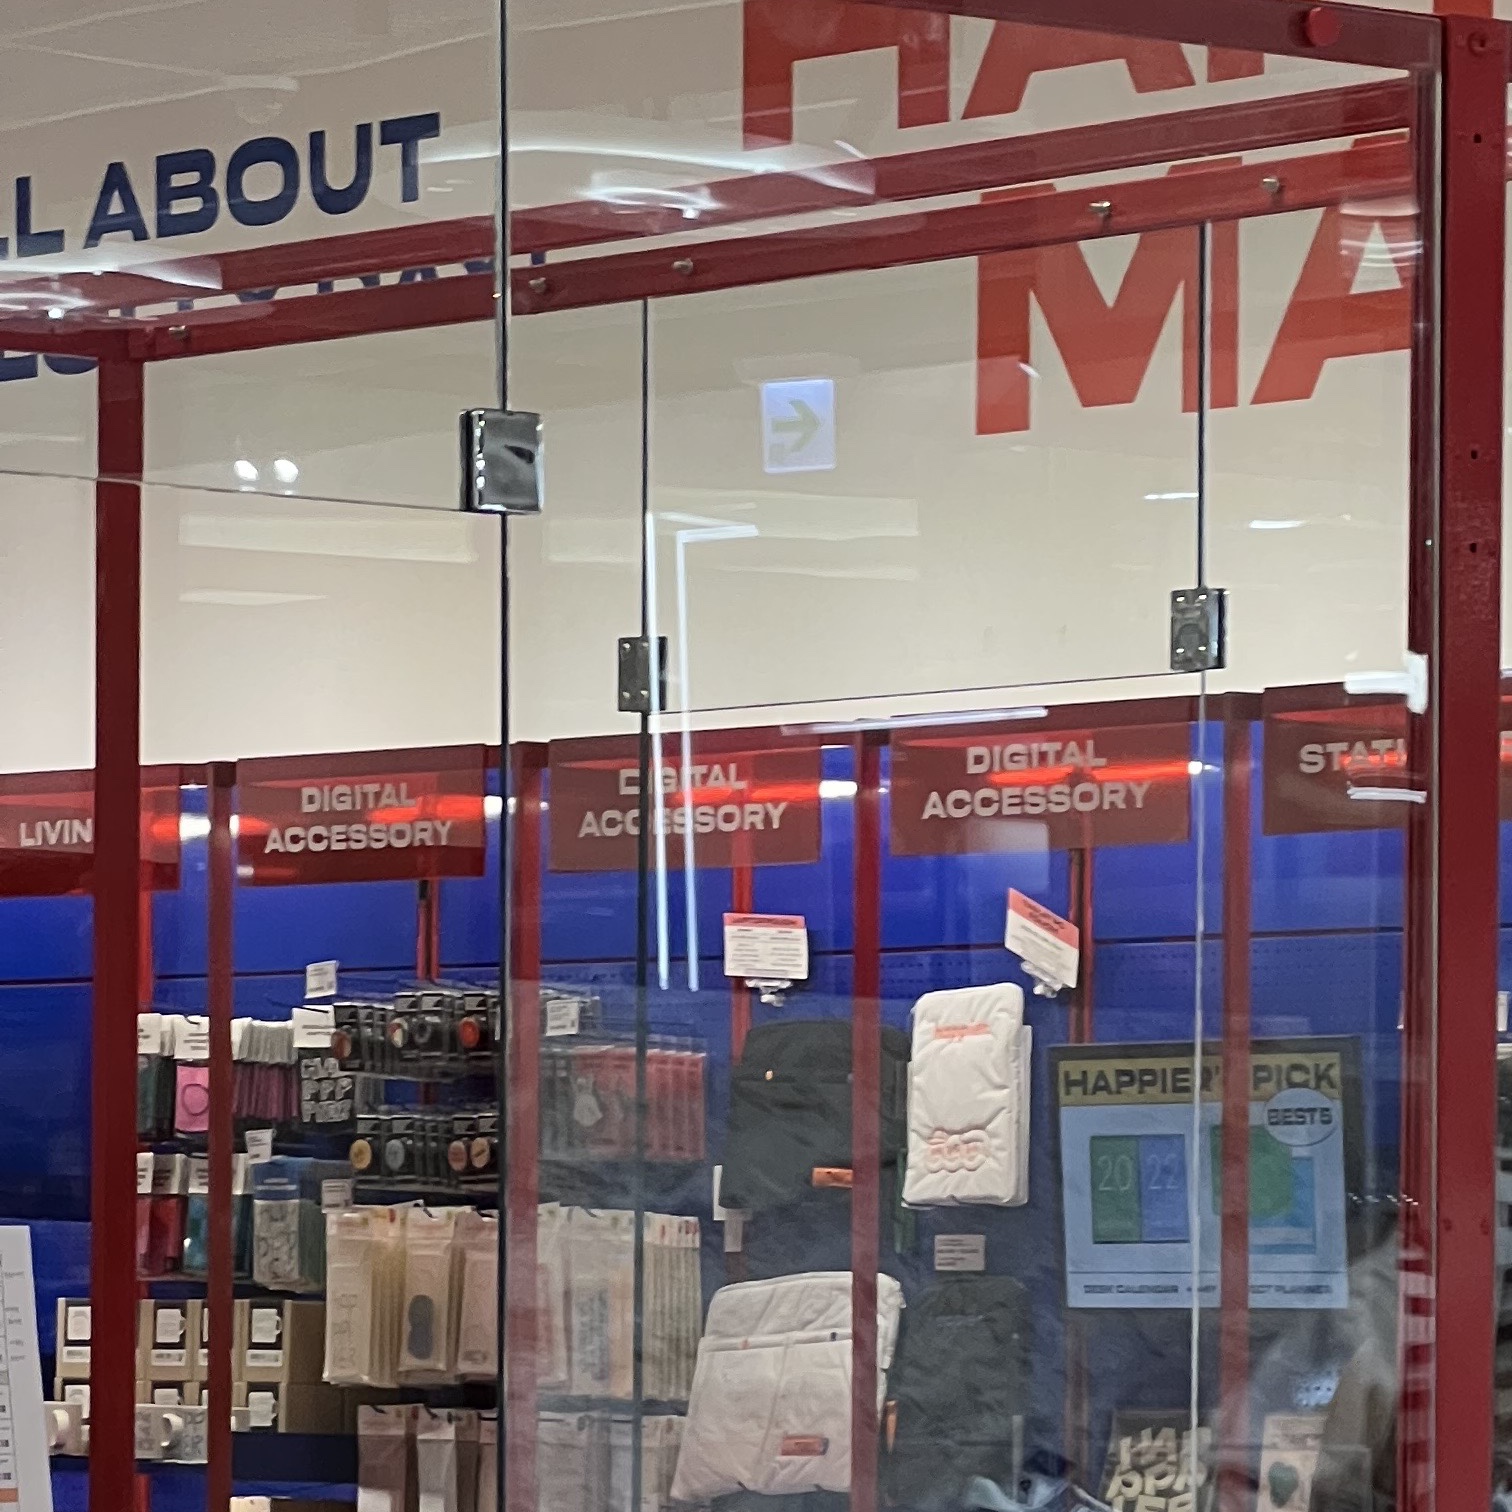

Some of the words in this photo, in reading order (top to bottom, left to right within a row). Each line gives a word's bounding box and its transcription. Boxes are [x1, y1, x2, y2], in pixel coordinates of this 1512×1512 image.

[84, 112, 441, 249] ABOUT
[966, 738, 1107, 775] DIGITAL
[301, 784, 416, 814] DIGITAL
[921, 781, 1152, 820] ACCESSORY
[19, 817, 93, 847] LIVIN
[264, 820, 452, 854] ACCESSORY
[1253, 1062, 1337, 1091] PICK
